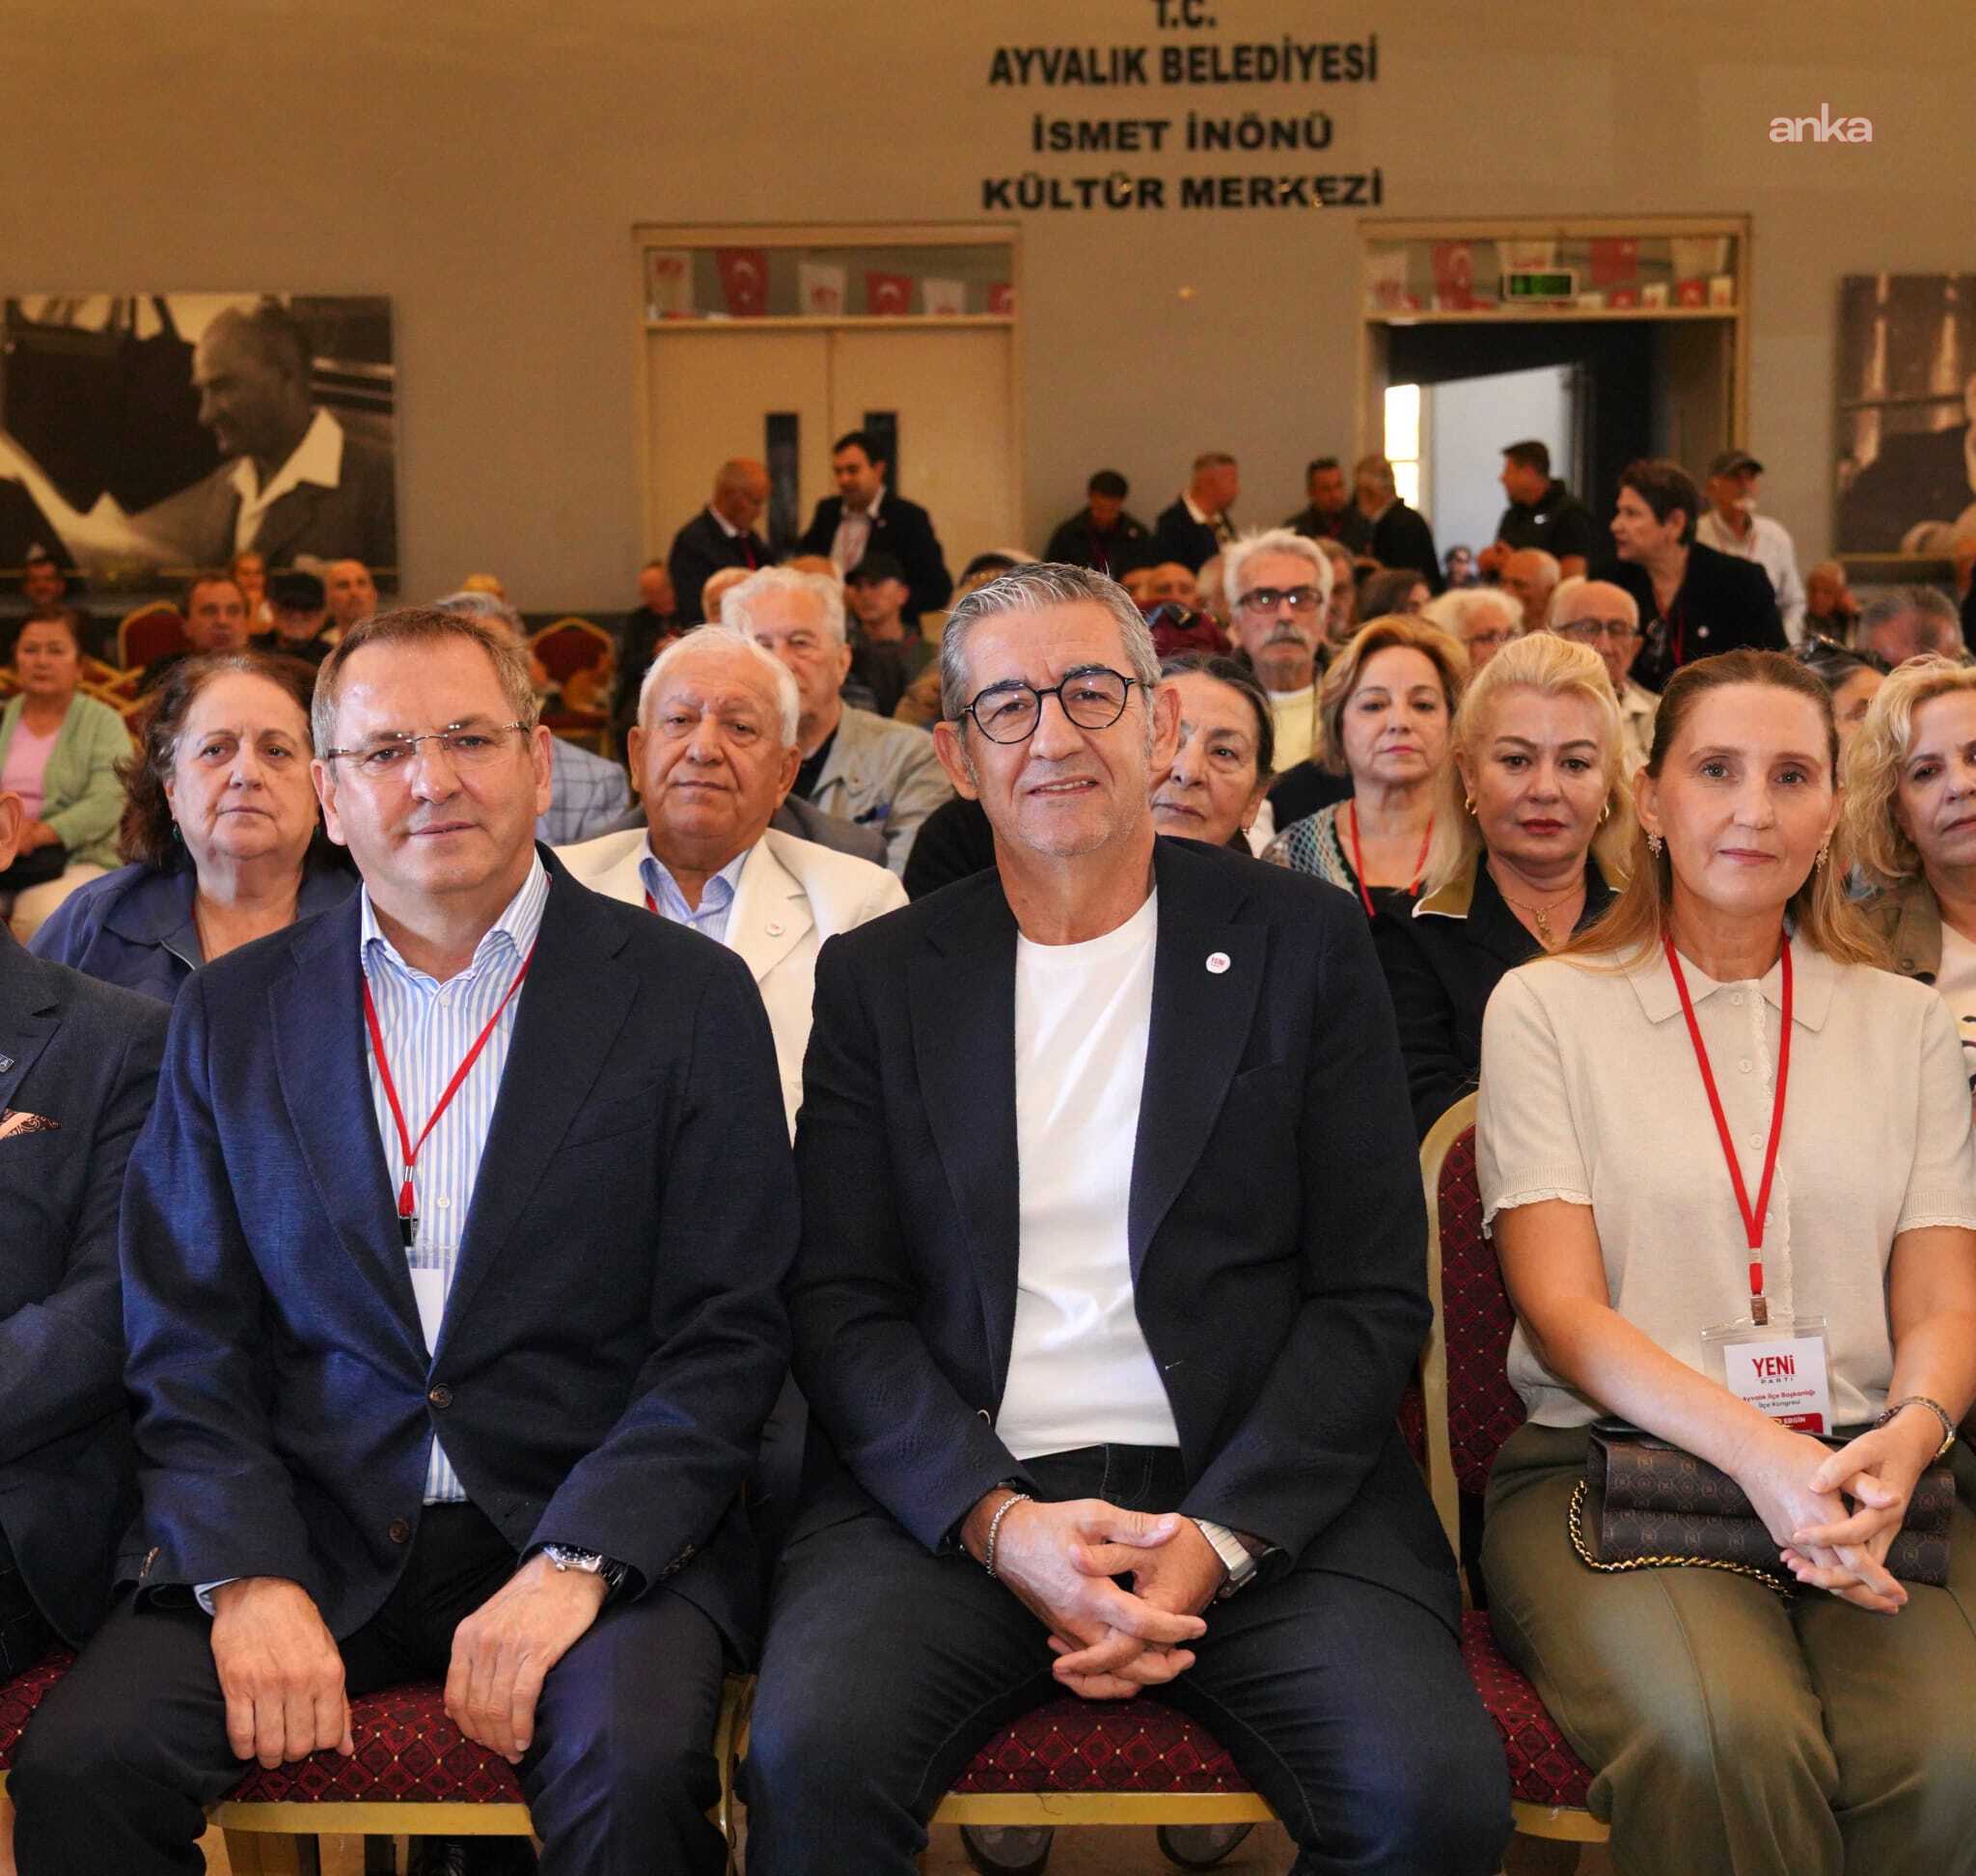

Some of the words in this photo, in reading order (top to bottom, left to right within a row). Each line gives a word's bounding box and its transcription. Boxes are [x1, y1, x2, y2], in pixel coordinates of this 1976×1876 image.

[1154, 0, 1219, 29] T.C.
[989, 47, 1148, 85] AYVALIK
[1162, 35, 1378, 83] BELEDİYESİ
[1032, 114, 1170, 152] İSMET
[1187, 111, 1333, 151] İNÖNÜ
[982, 173, 1165, 209] KÜLTÜR
[1181, 168, 1383, 208] MERKEZİ
